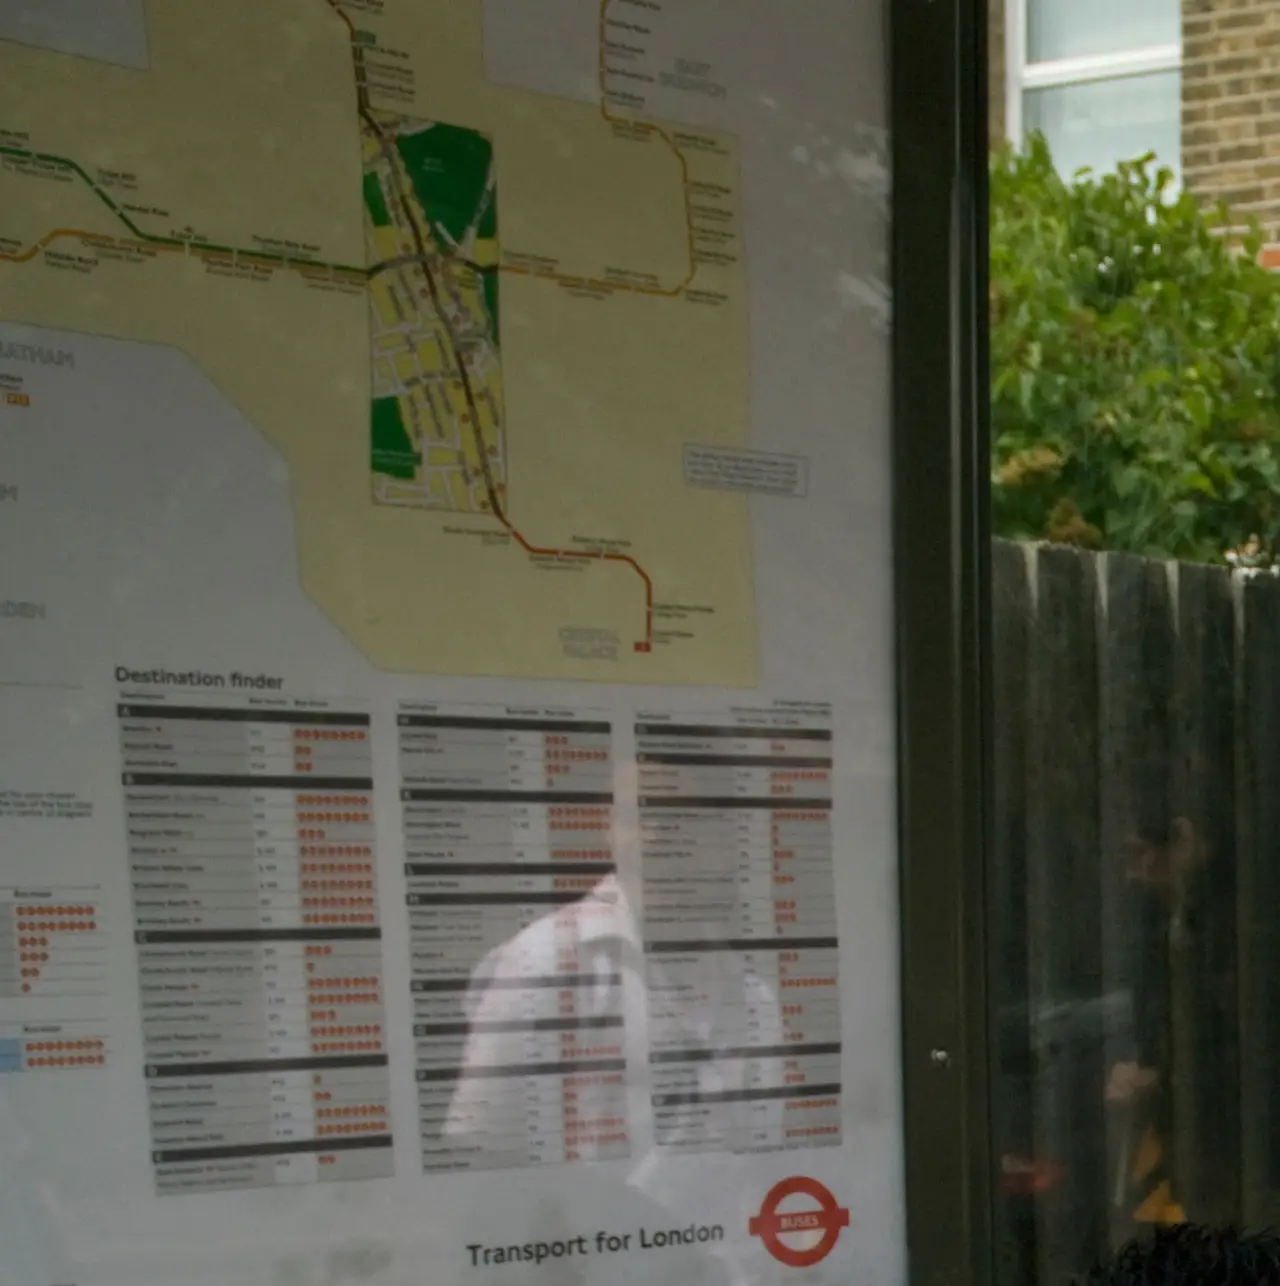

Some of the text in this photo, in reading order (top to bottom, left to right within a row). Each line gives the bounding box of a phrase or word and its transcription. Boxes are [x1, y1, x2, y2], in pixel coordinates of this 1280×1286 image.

[115, 666, 284, 691] Destination finder
[779, 1215, 820, 1230] BUSES
[466, 1222, 725, 1267] Transport for London
